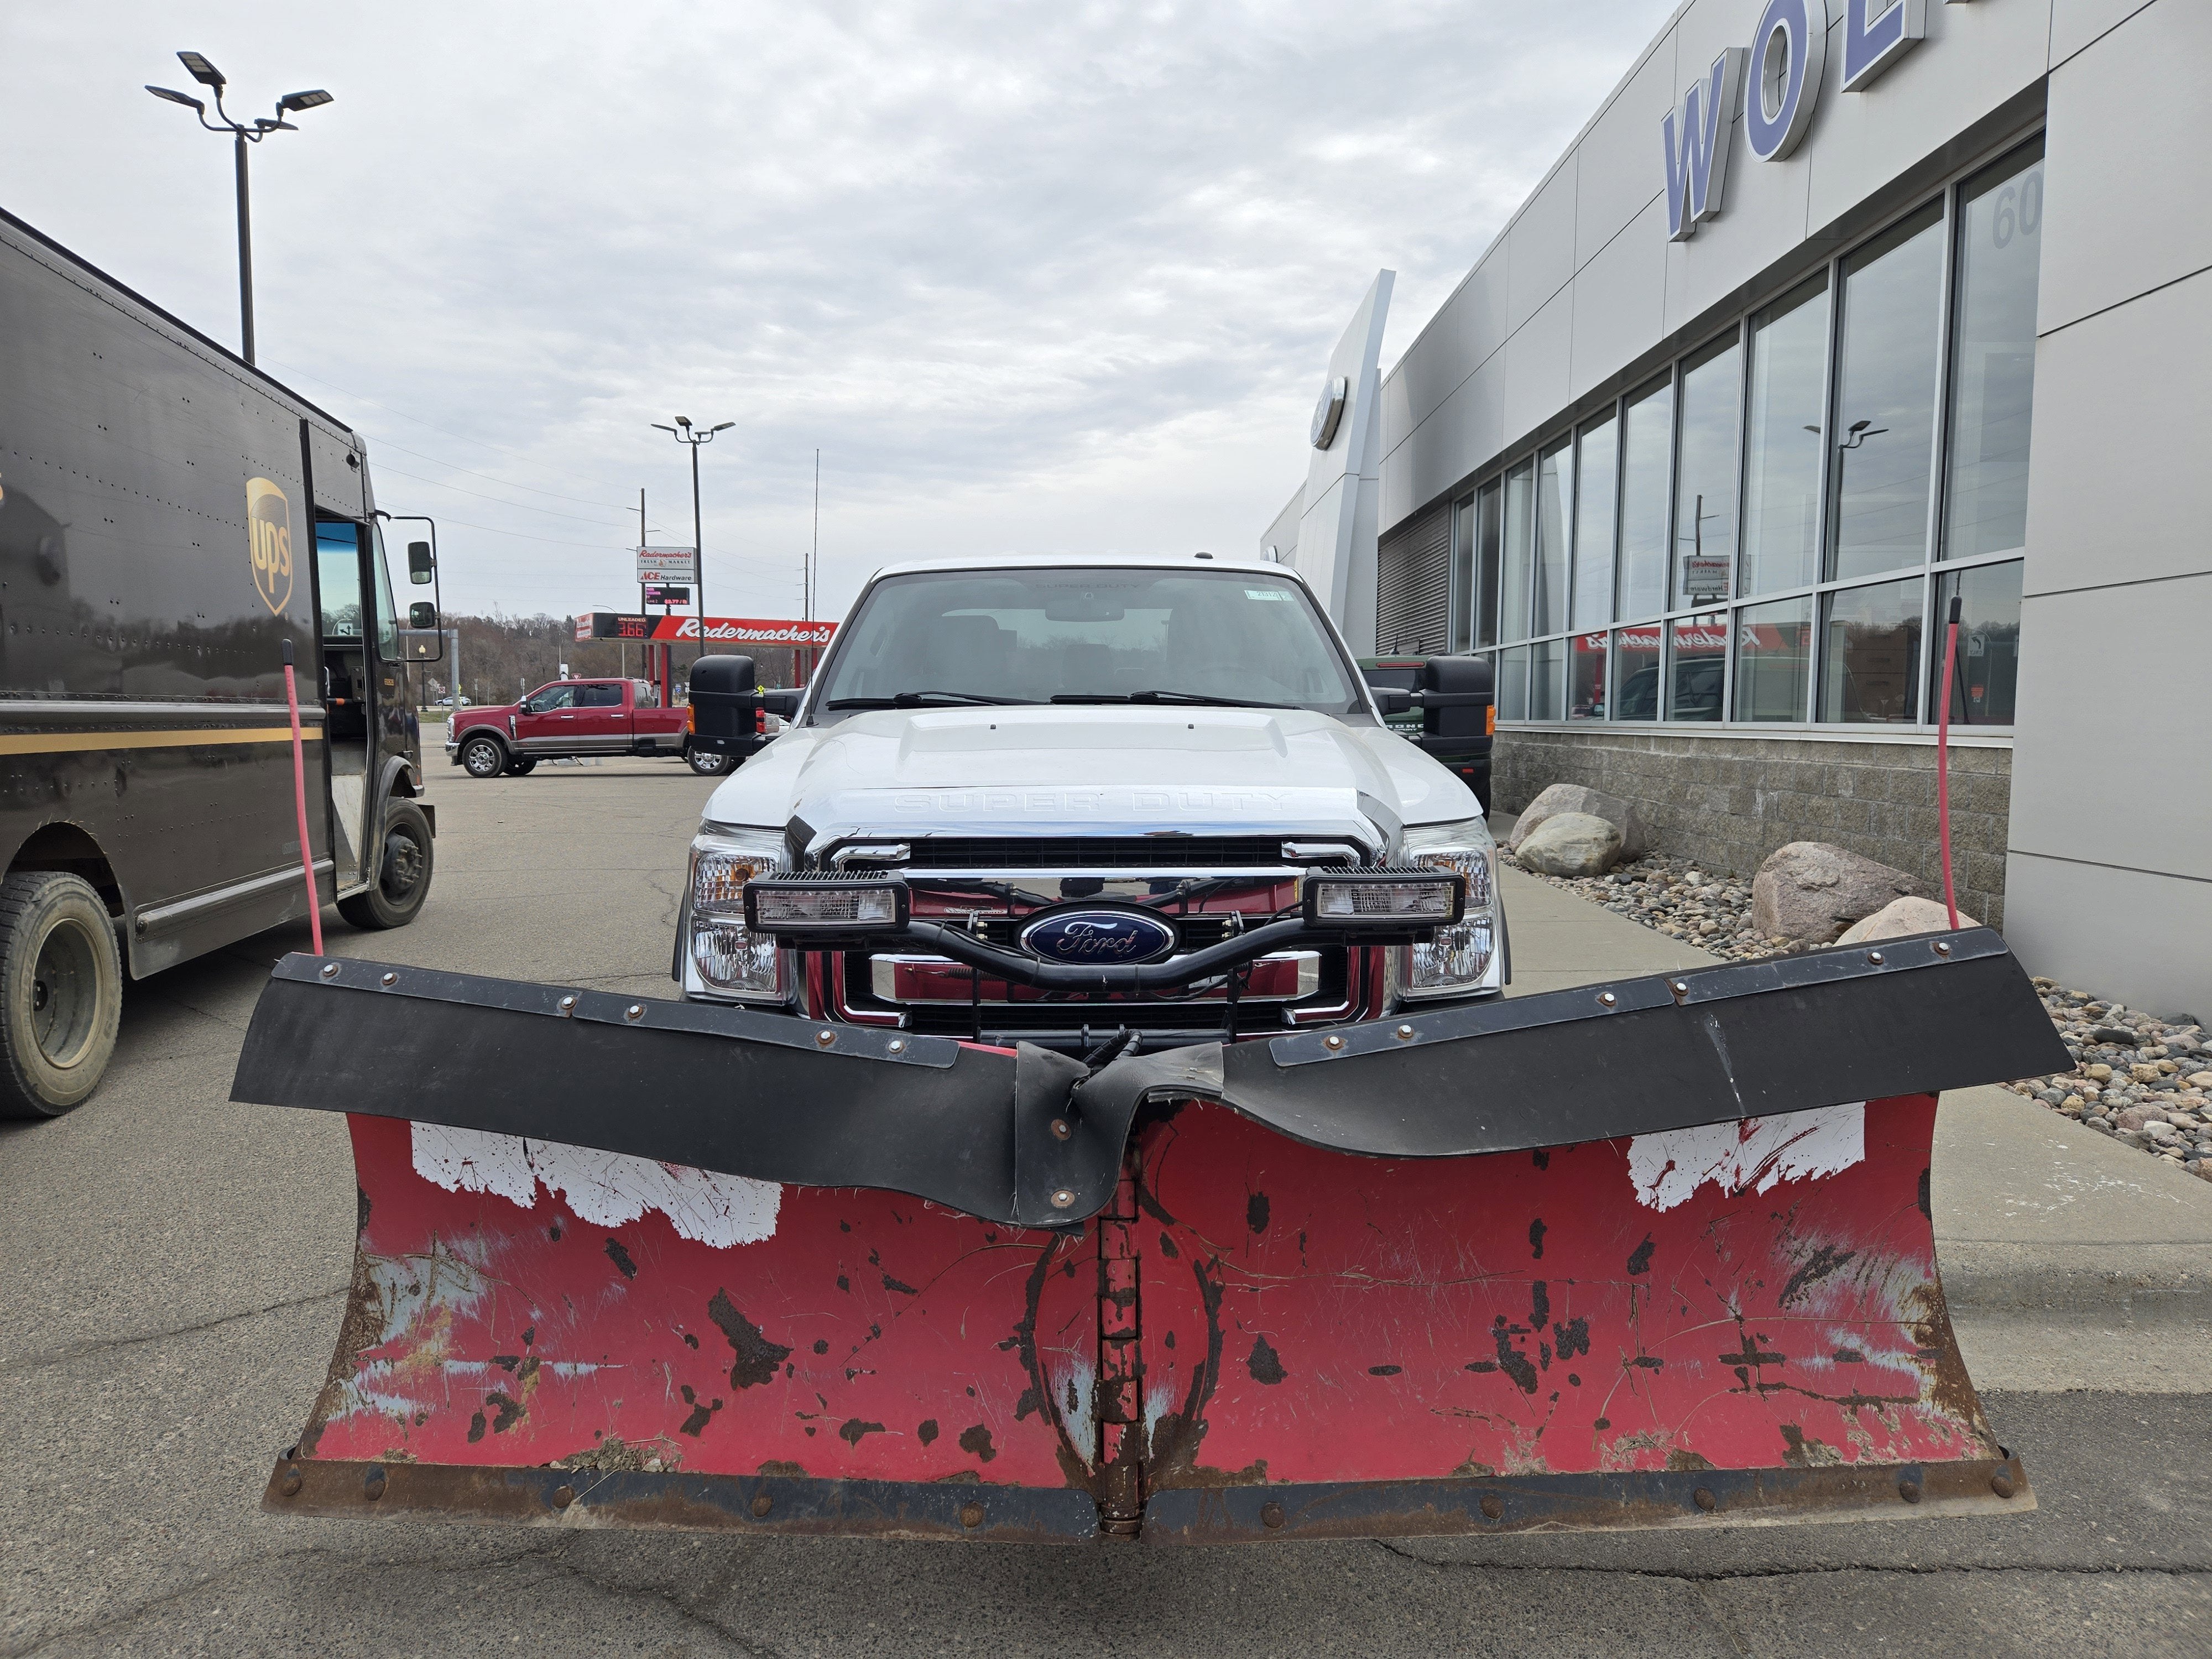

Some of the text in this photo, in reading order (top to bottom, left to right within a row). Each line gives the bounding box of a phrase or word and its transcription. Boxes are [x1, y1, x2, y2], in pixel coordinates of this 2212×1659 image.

[252, 517, 290, 593] ups
[639, 550, 691, 558] Radermacher's
[640, 571, 660, 580] ACE
[676, 618, 831, 642] Radermacher's
[894, 792, 1294, 813] SUPER DUTY
[1056, 921, 1139, 956] Ford
